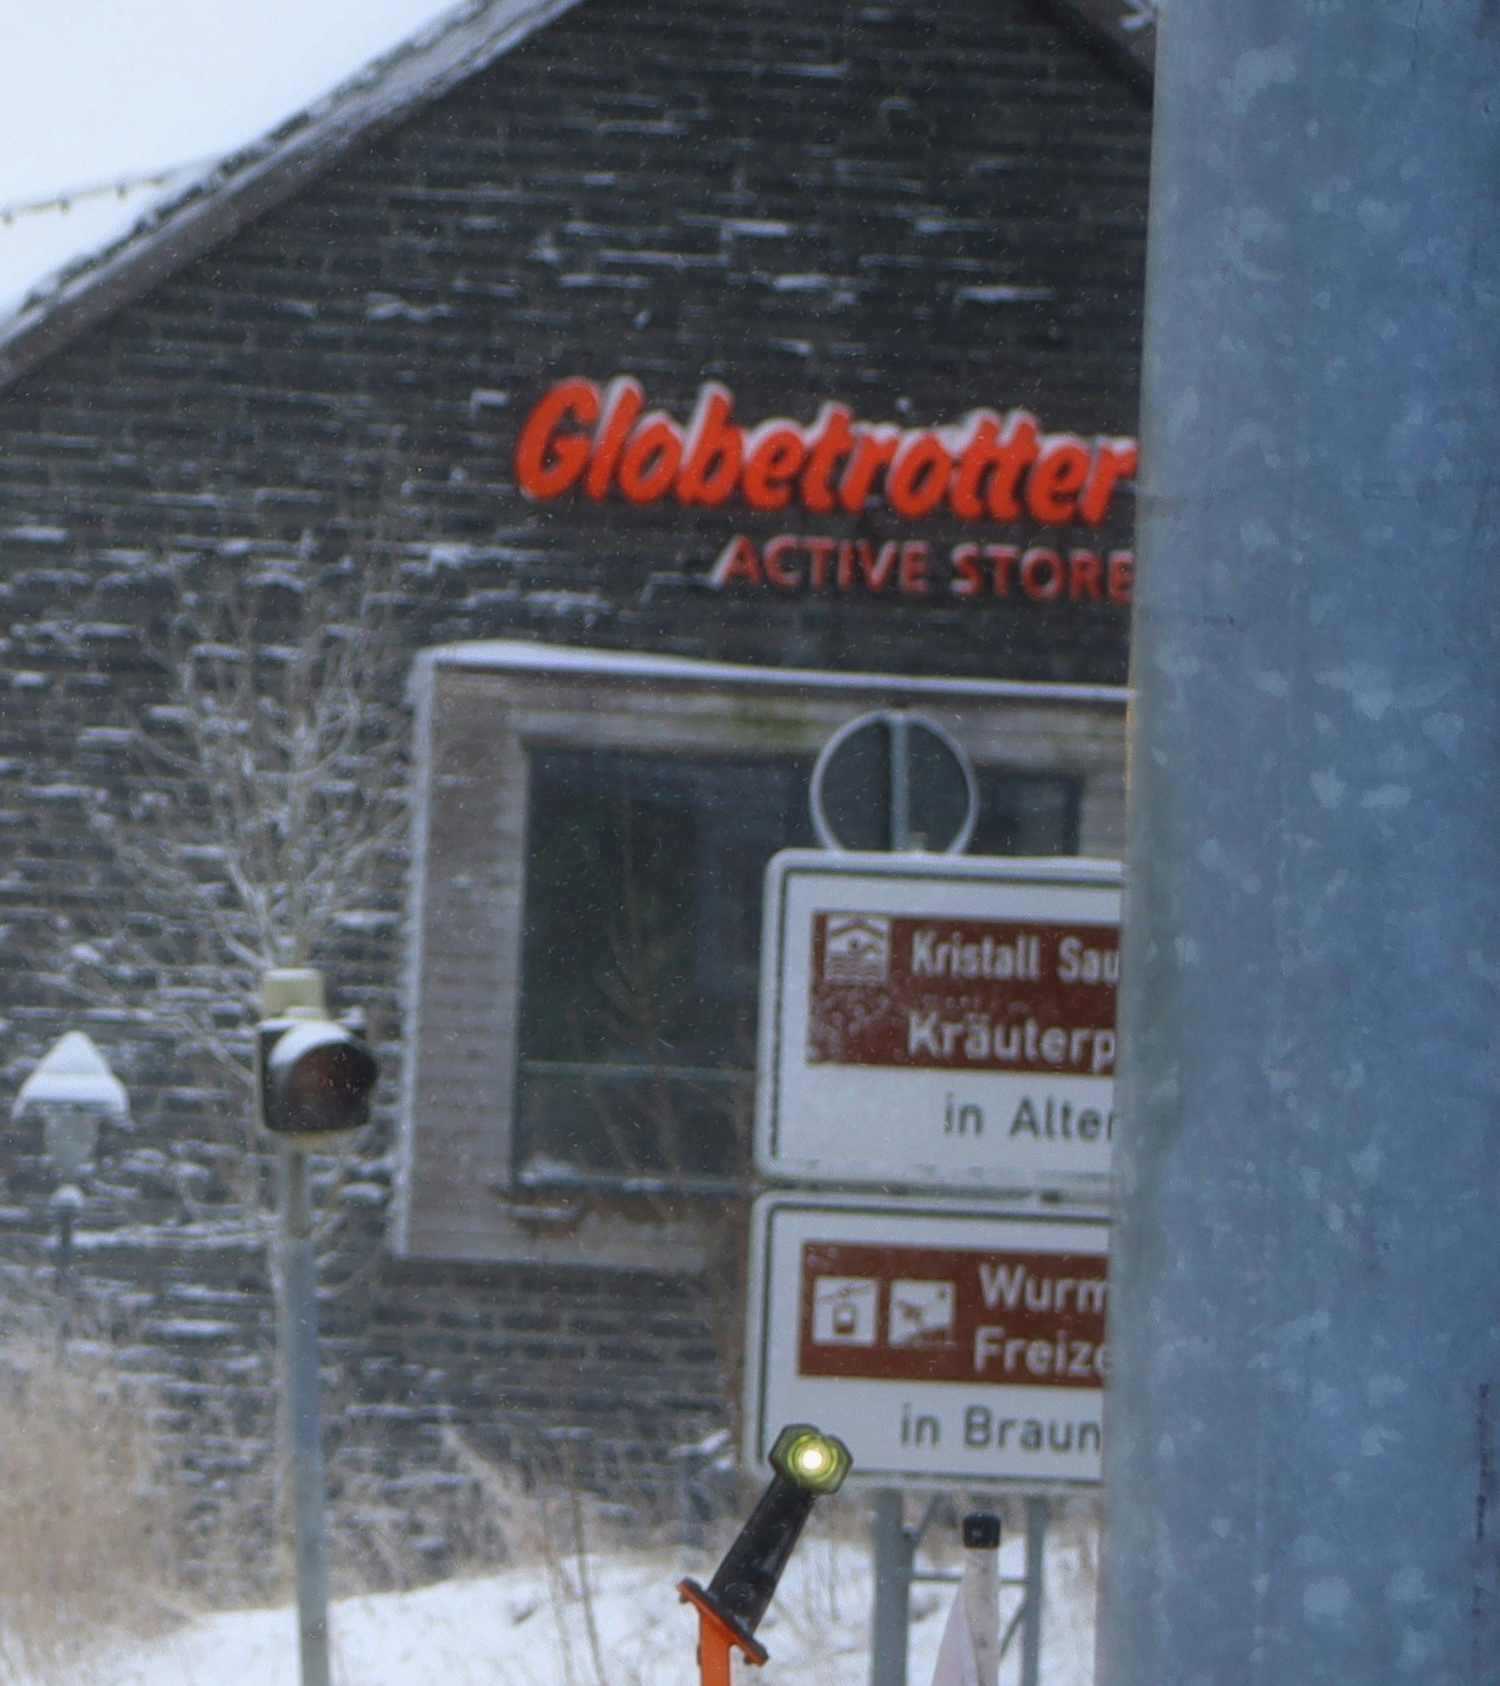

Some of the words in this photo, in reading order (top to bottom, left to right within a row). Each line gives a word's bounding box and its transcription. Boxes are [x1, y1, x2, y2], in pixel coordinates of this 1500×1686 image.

[512, 376, 1139, 527] Globetrotter
[720, 535, 933, 594] ACTIVE
[951, 542, 1135, 605] STORE
[910, 930, 1040, 983] Kristall
[906, 1010, 1116, 1073] Kräuterp
[943, 1092, 983, 1136] in
[900, 1402, 940, 1445] in
[964, 1405, 1103, 1453] Braun
